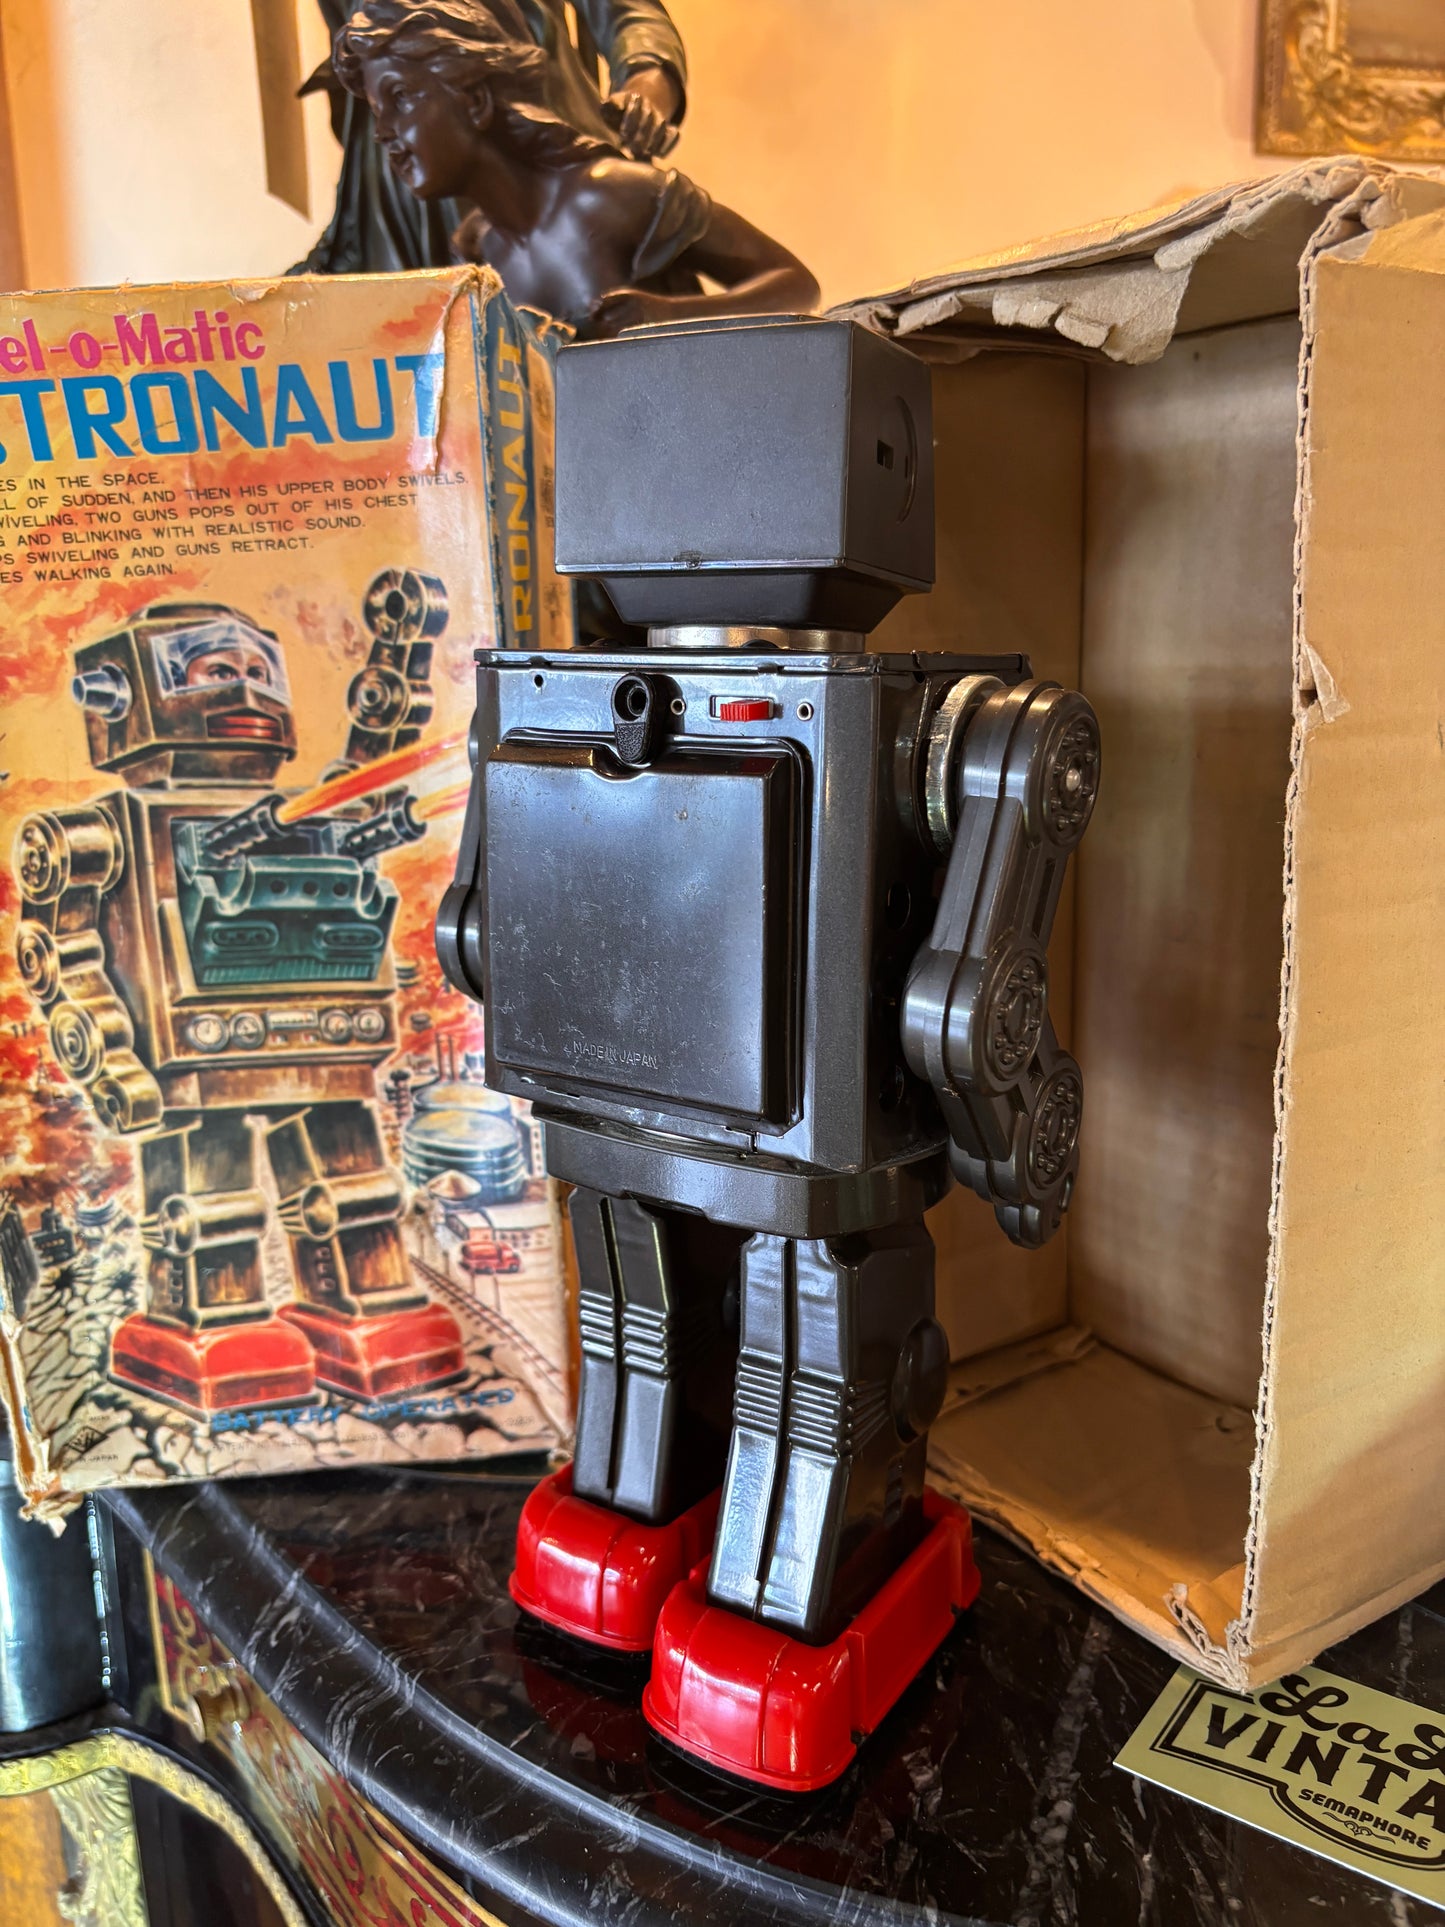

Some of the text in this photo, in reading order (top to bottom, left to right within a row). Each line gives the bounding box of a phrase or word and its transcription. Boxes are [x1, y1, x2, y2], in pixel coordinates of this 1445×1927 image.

[0, 353, 444, 465] TRONAUT
[27, 496, 49, 509] OF
[143, 490, 176, 503] AND
[184, 488, 231, 501] THEN
[239, 484, 268, 498] HIS
[277, 480, 334, 496] UPPER
[344, 477, 388, 492] BODY
[398, 472, 469, 488] SWIVELS.
[29, 478, 46, 490] IN
[56, 475, 91, 490] THE
[103, 472, 165, 486] SPACE.
[498, 327, 533, 648] RONAUT
[84, 511, 121, 524] TWO
[133, 508, 178, 522] GUNS
[189, 505, 235, 519] POPS
[246, 502, 279, 516] OUT
[291, 500, 313, 513] OF
[325, 498, 353, 511] HIS
[364, 493, 418, 509] CHEST
[17, 533, 51, 547] AND
[62, 529, 142, 544] BLINKING
[153, 526, 195, 539] WITH
[205, 520, 294, 536] REALISTIC
[305, 516, 366, 530] SOUND.
[26, 548, 119, 564] SWIVELING
[131, 546, 165, 559] AND
[176, 542, 221, 556] GUNS
[232, 537, 314, 552] RETRACT.
[1, 563, 177, 584] ES WALKING AGAIN.
[573, 1041, 658, 1070] MADE IN JAPAN
[210, 1388, 515, 1432] BATTERY OPERATED
[1205, 1703, 1445, 1834] VINTA
[1298, 1788, 1432, 1850] SEMAPHORE
